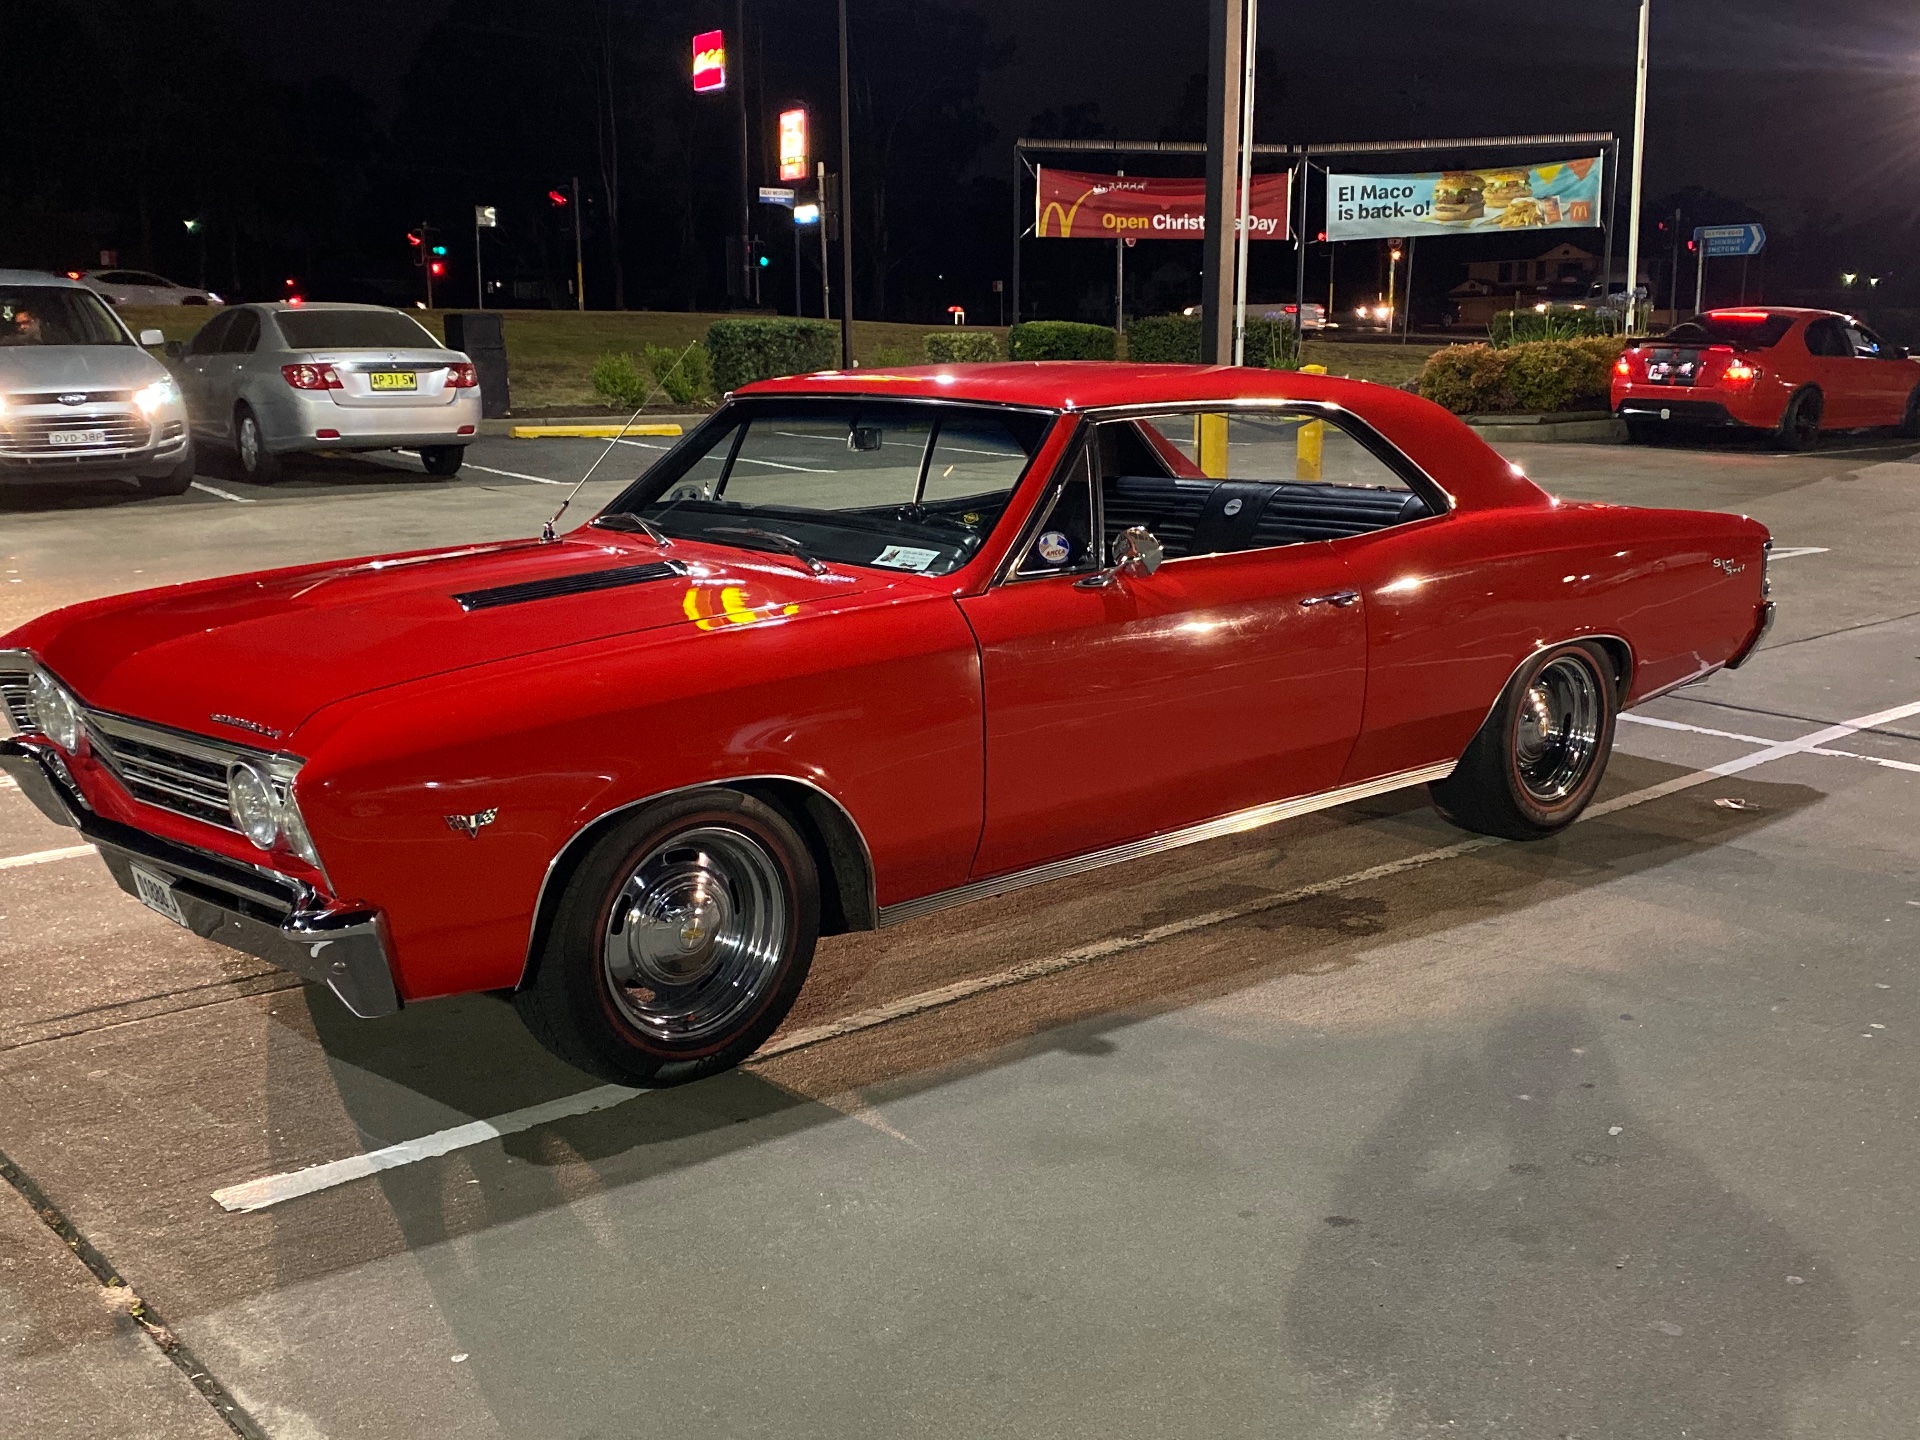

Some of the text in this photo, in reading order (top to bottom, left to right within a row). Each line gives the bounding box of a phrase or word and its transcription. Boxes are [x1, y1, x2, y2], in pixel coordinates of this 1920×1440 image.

[1338, 184, 1414, 202] El Maco
[1338, 200, 1431, 221] is back-o!
[1102, 212, 1278, 235] Open Christs Day
